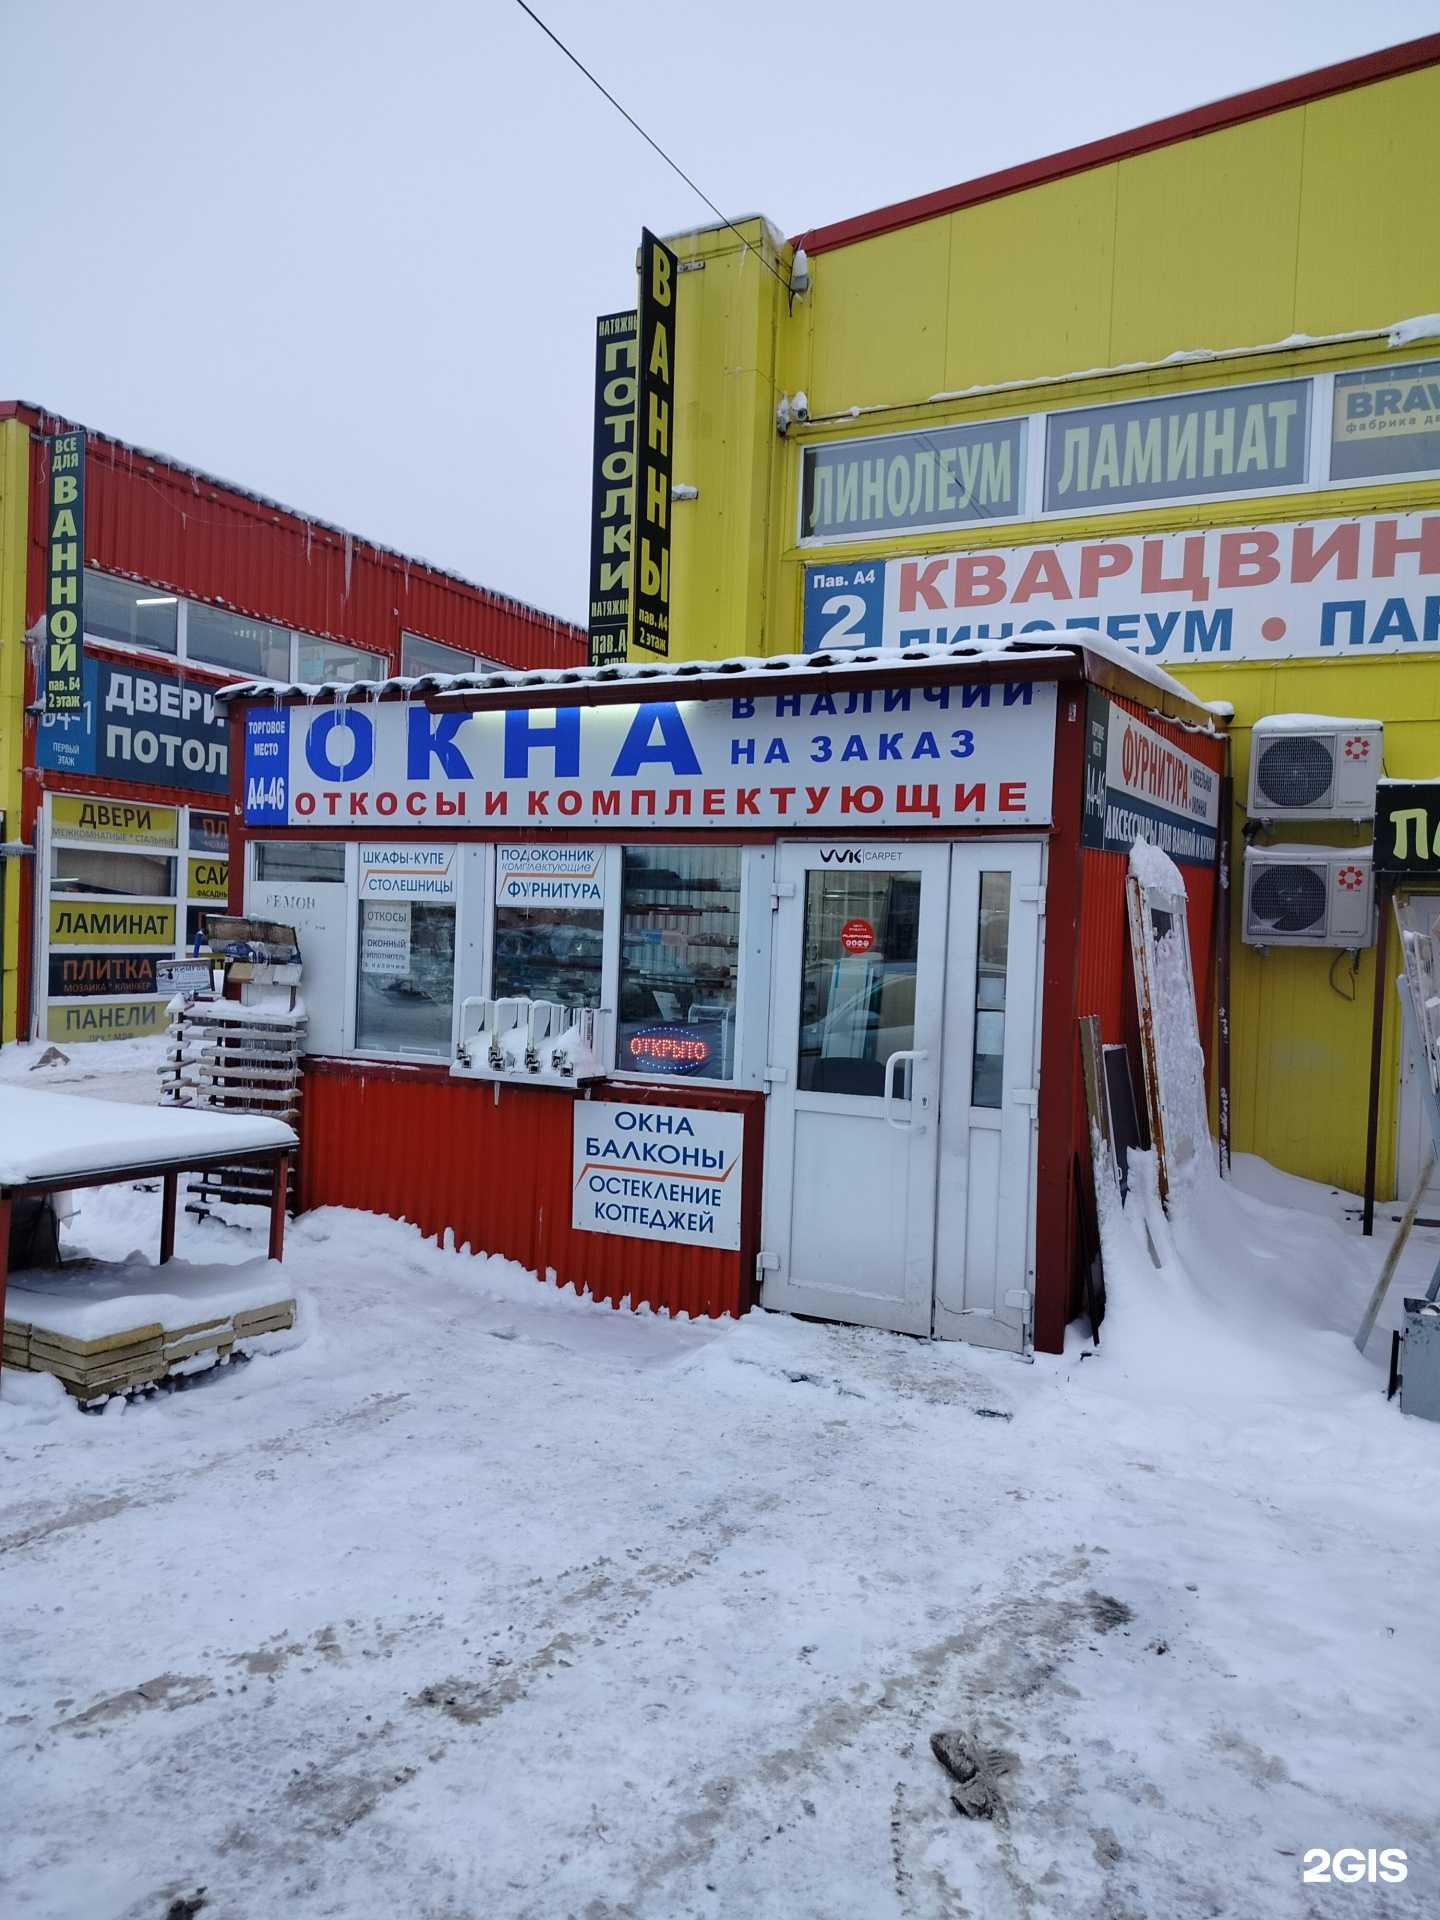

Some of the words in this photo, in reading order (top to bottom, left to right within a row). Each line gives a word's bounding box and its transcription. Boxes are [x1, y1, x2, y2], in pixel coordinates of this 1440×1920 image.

[640, 243, 671, 602] ВАННЫ
[1345, 416, 1417, 434] фабрика
[55, 438, 77, 453] ВСЕ
[1058, 400, 1298, 494] ЛАМИНАТ
[52, 453, 79, 472] ДЛЯ
[599, 341, 637, 591] ПОТОЛКИ
[809, 440, 1012, 528] ЛИНОЛЕУМ
[50, 476, 78, 673] ВАННОЙ
[899, 517, 1440, 612] КВАРЦВИН
[813, 574, 848, 589] Пав.
[854, 572, 876, 586] А4
[639, 609, 657, 627] пав.
[818, 594, 867, 649] 2
[640, 627, 646, 643] 2
[646, 632, 666, 652] этаж
[48, 679, 68, 691] пав.
[48, 693, 55, 708] 2
[56, 695, 80, 708] этаж
[732, 694, 755, 720] В
[775, 682, 1033, 718] НАЛИЧИИ
[248, 721, 286, 735] ТОРГОВОЕ
[253, 743, 279, 756] МЕСТО
[305, 702, 703, 783] ОКНА
[731, 738, 790, 765] НА
[810, 730, 975, 763] ЗАКАЗ
[1122, 725, 1189, 811] ФУРНИТУРА
[247, 777, 285, 811] А4-46
[294, 791, 466, 817] ОТКОСЫ
[485, 791, 508, 816] И
[527, 782, 1028, 818] КОМПЛЕКТУЮЩИЕ
[79, 803, 151, 830] ДВЕРИ
[1389, 807, 1440, 860] П
[363, 851, 444, 865] ШКАФЫ-КУПЕ
[501, 849, 594, 863] ПОДОКОННИК
[864, 851, 903, 861] CARPET
[368, 878, 453, 894] СТОЛЕШНИЦЫ
[507, 880, 601, 899] ФУРНИТУРА
[56, 912, 169, 935] ЛАМИНАТ
[367, 911, 407, 923] ОТКОСЫ
[63, 959, 153, 981] ПЛИТКА
[63, 982, 107, 993] МОЗАИКА
[66, 1006, 156, 1031] ПАНЕЛИ
[630, 1037, 707, 1060] ОТКРЫТО
[614, 1111, 695, 1136] ОКНА
[585, 1137, 724, 1170] БАЛКОНЫ
[588, 1175, 722, 1207] ОСТЕКЛЕНИЕ
